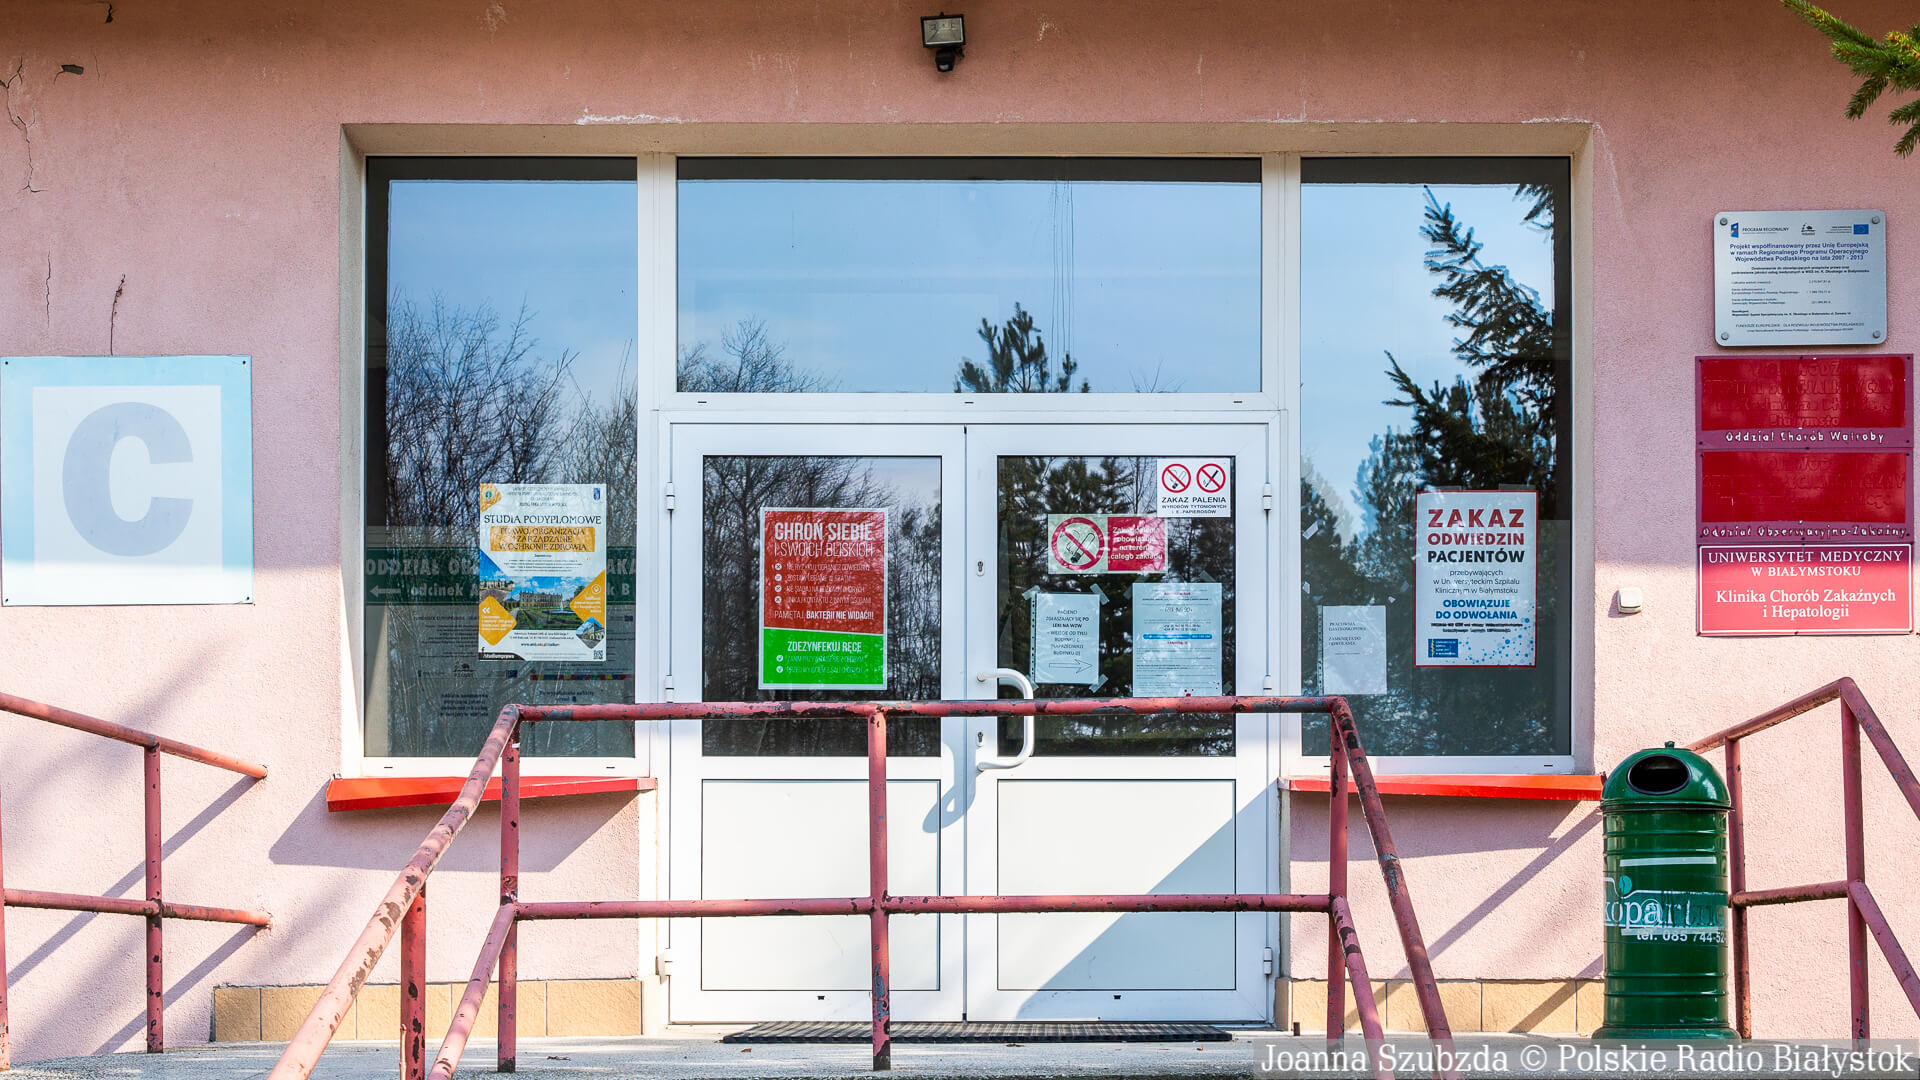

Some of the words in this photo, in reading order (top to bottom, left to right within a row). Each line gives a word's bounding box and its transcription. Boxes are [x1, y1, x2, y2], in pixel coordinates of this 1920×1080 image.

[1751, 243, 1804, 251] współfinansowany
[1837, 242, 1869, 250] Europejską
[62, 402, 194, 557] C
[484, 514, 520, 524] STUDIA
[524, 515, 602, 525] PODYPLOMOWE
[1428, 508, 1525, 528] ZAKAZ
[532, 527, 585, 535] ORGANIZACJA
[774, 519, 823, 541] CHROŃ
[827, 521, 874, 541] SIEBIE
[516, 535, 573, 544] ZARZĄDZANIE
[1427, 532, 1525, 546] ODWIEDZIN
[508, 543, 548, 551] OCHRONIE
[780, 541, 823, 557] SWOICH
[825, 541, 873, 557] BLISKICH
[1110, 553, 1135, 561] całego
[1427, 547, 1525, 563] PACJENTÓW
[1708, 551, 1814, 564] UNIWERSYTET
[1820, 550, 1904, 563] MEDYCZNY
[1449, 569, 1503, 577] przebywających
[1751, 566, 1763, 577] W
[1767, 565, 1862, 578] BIAŁYMSTOKU
[1441, 578, 1494, 587] Unwersyteckim
[1494, 578, 1520, 587] Szpitalu
[410, 582, 463, 597] odcinek
[621, 583, 630, 596] B
[1715, 589, 1766, 603] Klinika
[1770, 588, 1820, 603] Chorób
[1823, 588, 1897, 606] Zakaźnych
[1442, 599, 1511, 610] OBOWIĄZUJE
[806, 610, 834, 619] BAKTERII
[835, 610, 847, 619] NIE
[847, 609, 874, 620] WIDAĆ!!!
[1435, 611, 1452, 620] DO
[1453, 611, 1518, 620] ODWOŁANIA
[1763, 604, 1768, 618] i
[1772, 604, 1850, 621] Hepatologii
[787, 640, 840, 652] ZDEZYNFEKUJ
[842, 641, 862, 654] RĘCE
